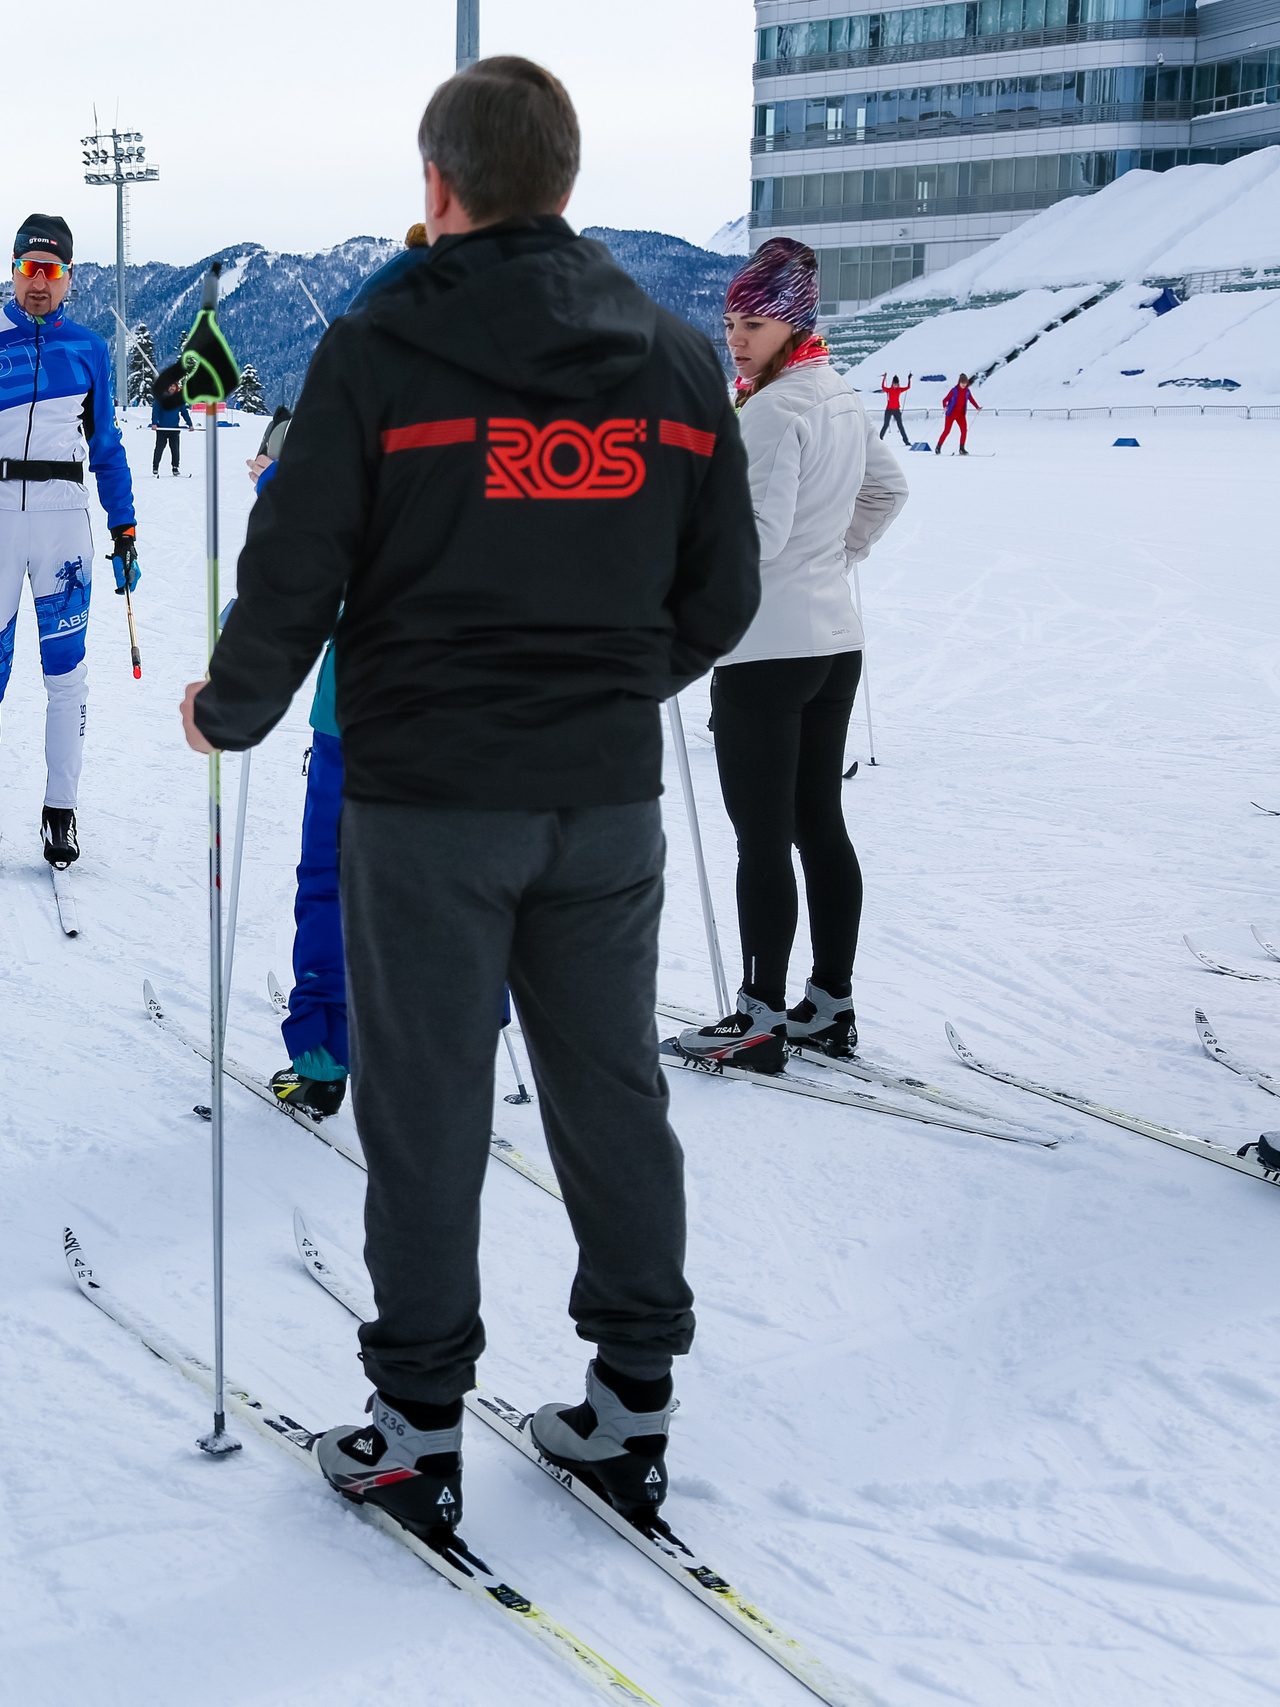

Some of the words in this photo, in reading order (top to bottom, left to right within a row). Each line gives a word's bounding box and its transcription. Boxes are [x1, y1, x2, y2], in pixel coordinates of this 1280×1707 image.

[485, 418, 647, 499] ROS
[57, 606, 91, 631] ABS
[714, 1026, 732, 1034] TISA
[1263, 1169, 1280, 1183] TI
[77, 1269, 93, 1279] 157
[379, 1411, 407, 1437] 236
